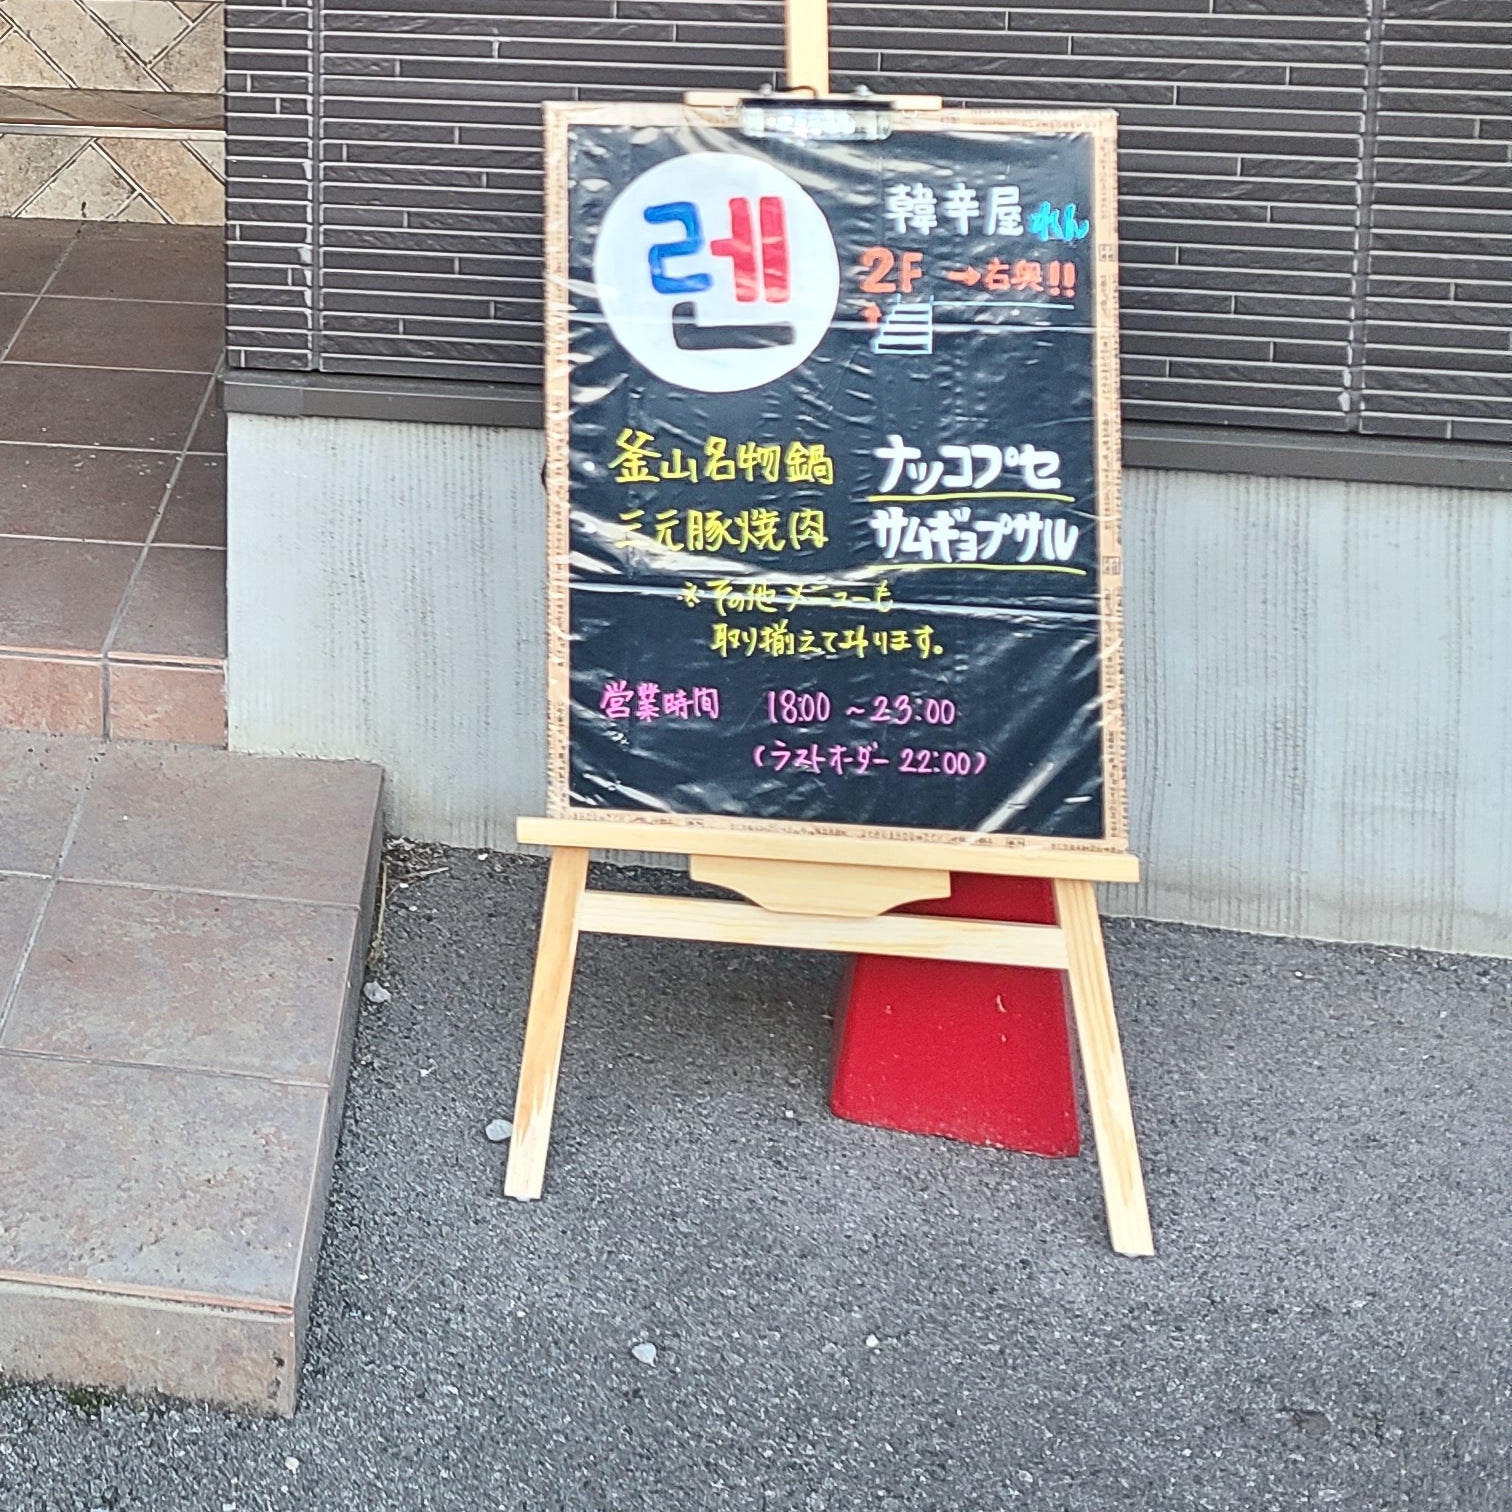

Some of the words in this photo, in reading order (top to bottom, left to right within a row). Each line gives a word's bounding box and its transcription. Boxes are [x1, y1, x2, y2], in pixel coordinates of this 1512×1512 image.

[884, 183, 1024, 236] 韓辛屋
[643, 196, 796, 350] 렌
[859, 246, 924, 295] 2F
[607, 427, 835, 486] 釜山名物鍋
[873, 433, 1062, 495] ナッコプセ
[868, 506, 1080, 563] サムギョプサル
[599, 679, 720, 722] 営業時間
